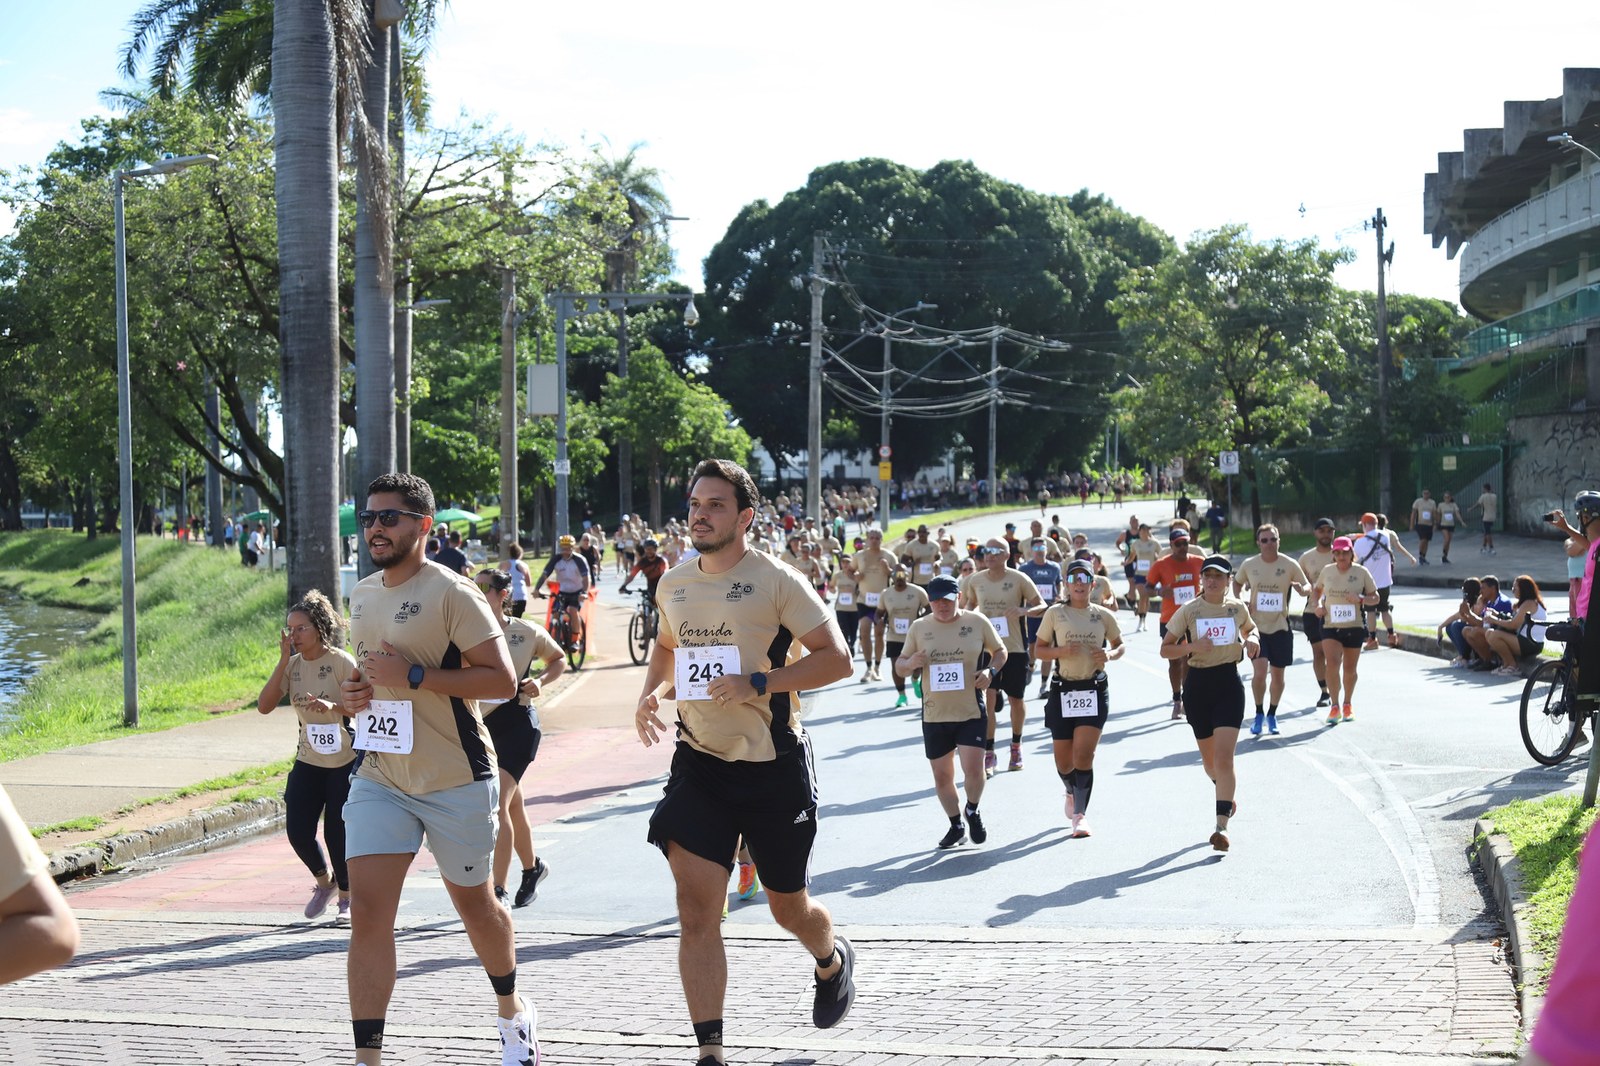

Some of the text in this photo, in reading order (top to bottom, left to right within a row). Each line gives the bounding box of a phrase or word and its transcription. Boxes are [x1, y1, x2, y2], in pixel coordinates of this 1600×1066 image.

[679, 621, 733, 636] Corrida
[1206, 626, 1226, 637] 497
[1065, 632, 1096, 640] Corrida
[930, 648, 964, 658] Corrida
[688, 663, 724, 682] 243
[938, 672, 958, 682] 229
[1066, 699, 1092, 708] 1282
[368, 715, 398, 736] 242
[312, 734, 334, 744] 788
